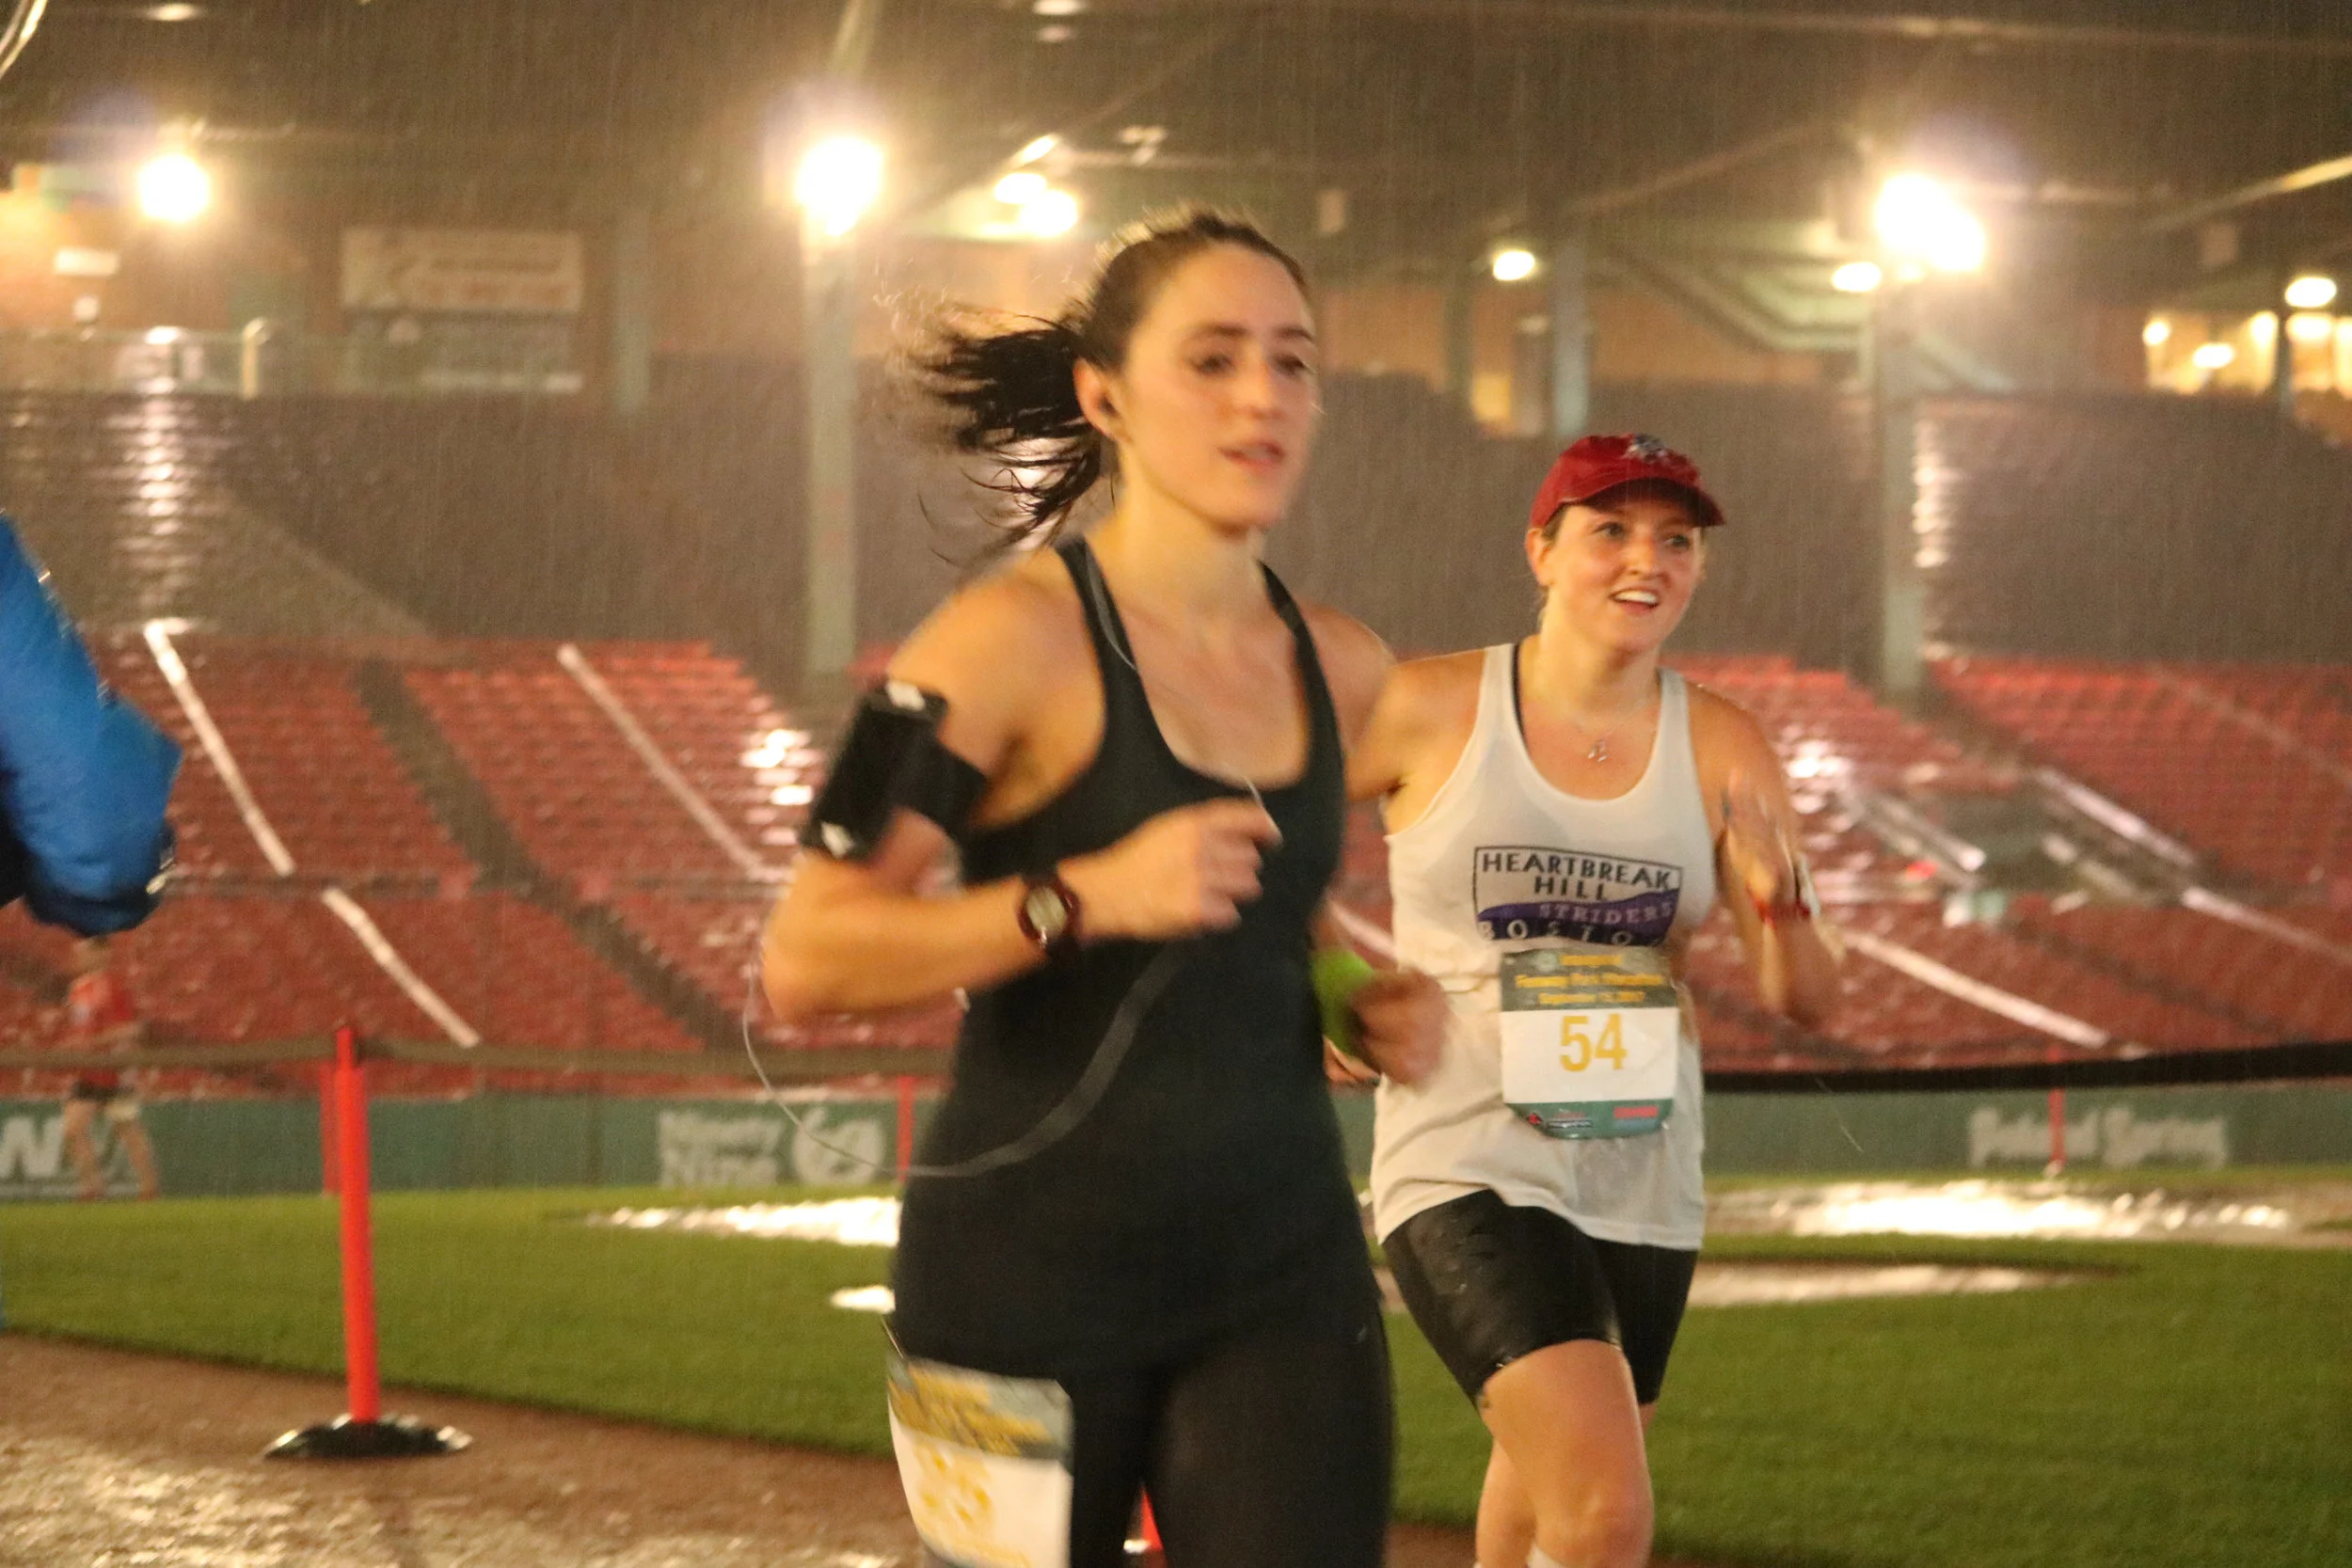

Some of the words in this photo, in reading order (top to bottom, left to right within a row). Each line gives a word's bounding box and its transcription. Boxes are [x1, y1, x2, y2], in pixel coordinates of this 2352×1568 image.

[1482, 852, 1671, 889] HEARTBREAK
[1534, 876, 1606, 900] HILL
[1539, 901, 1673, 925] STRIDERS
[1560, 1013, 1628, 1071] 54
